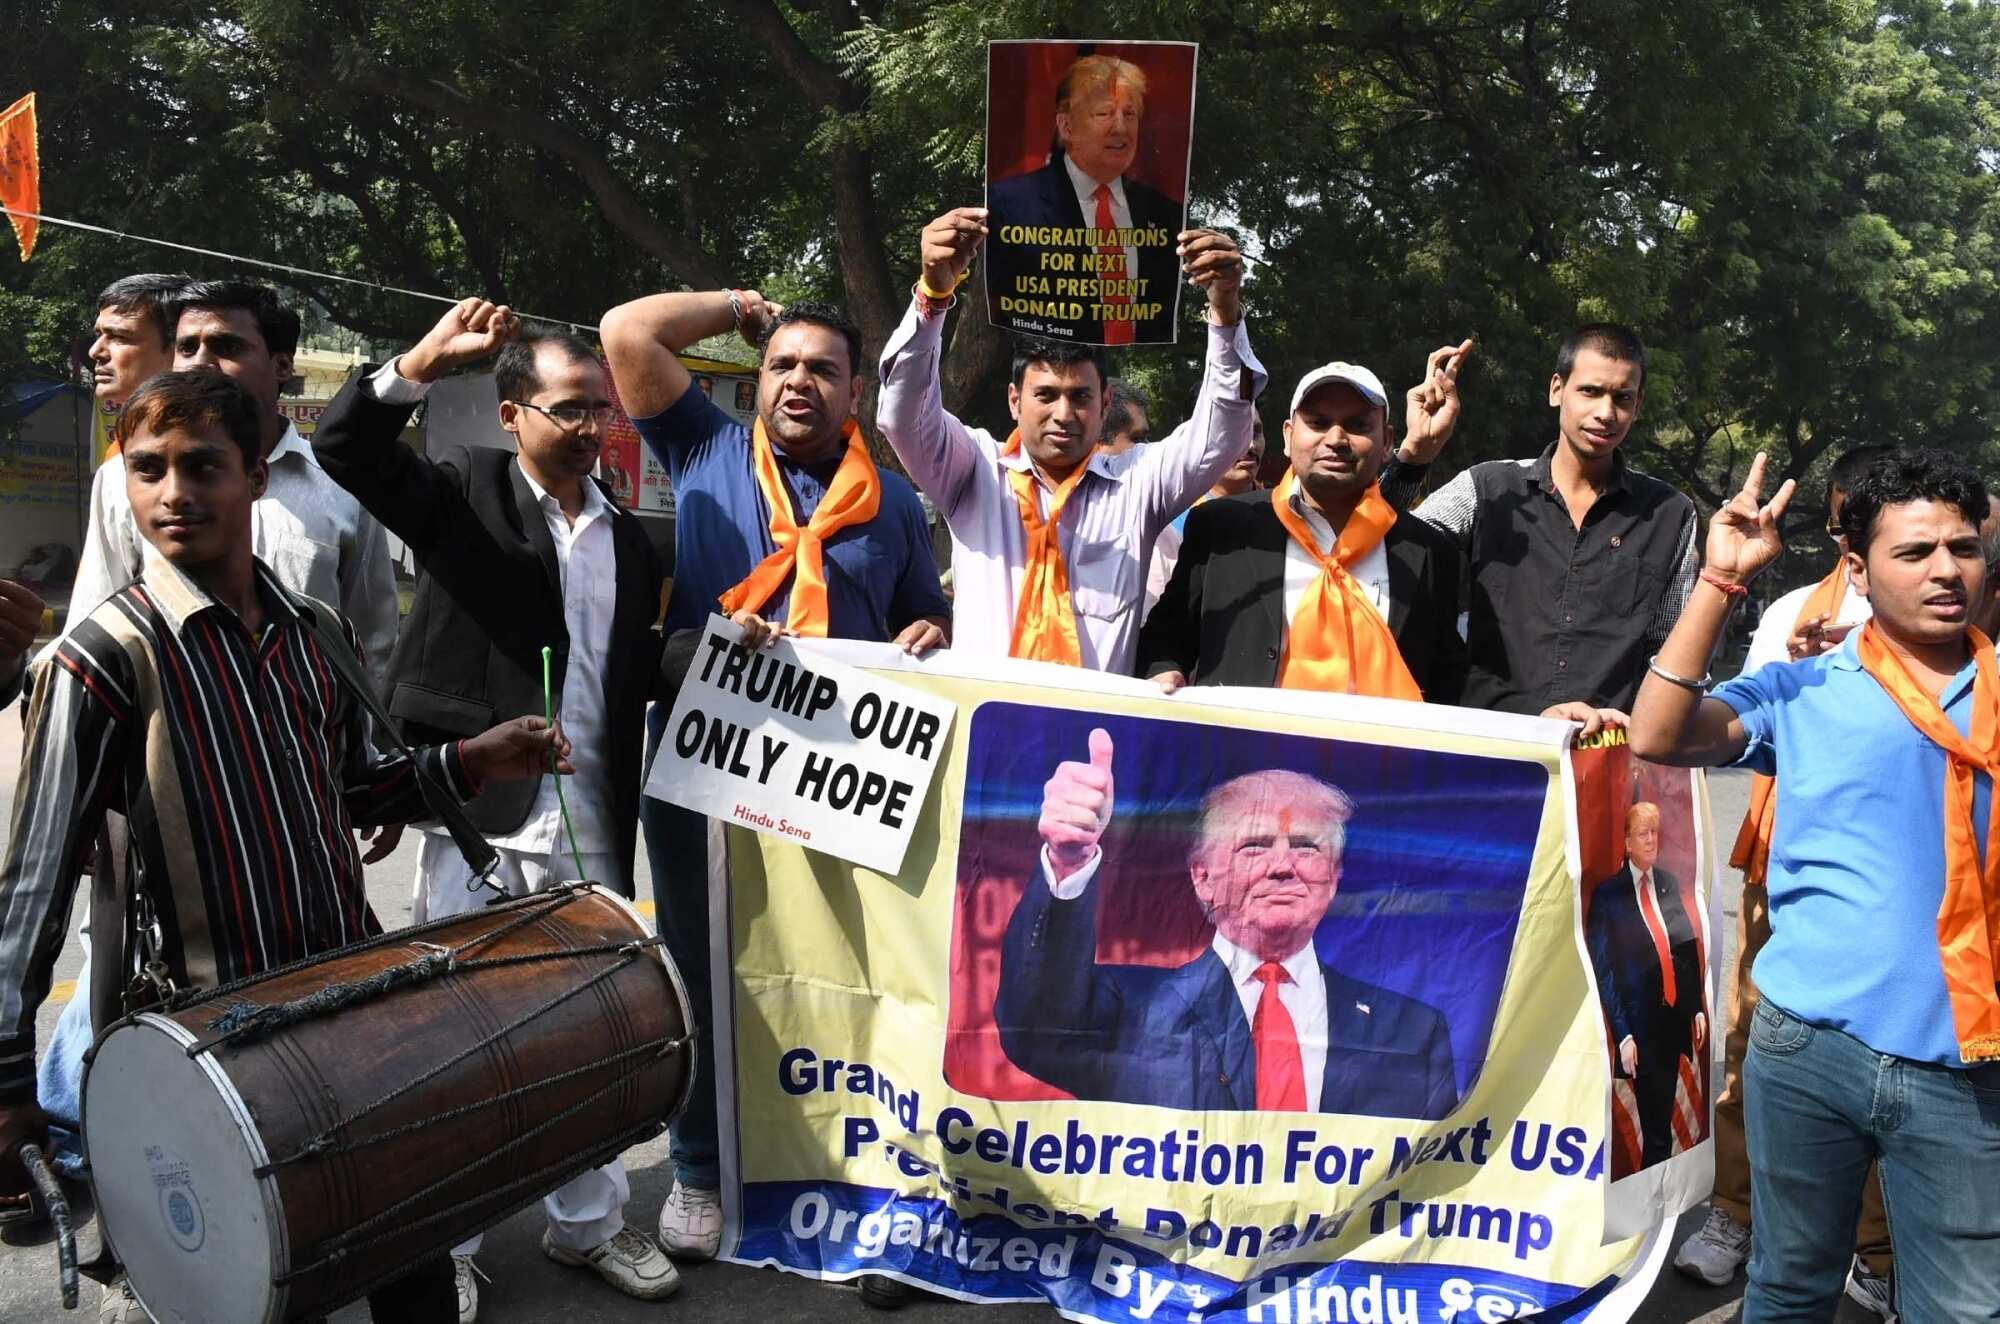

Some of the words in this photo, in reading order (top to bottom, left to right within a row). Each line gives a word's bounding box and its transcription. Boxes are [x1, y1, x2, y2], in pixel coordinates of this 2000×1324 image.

[1000, 224, 1168, 247] CONGRATULATIONS
[1041, 252, 1075, 271] FOR
[1082, 253, 1127, 272] NEXT
[1015, 275, 1050, 295] USA
[1056, 277, 1149, 297] PRESIDENT
[1000, 296, 1083, 320] DONALD
[1090, 302, 1162, 321] TRUMP
[1012, 317, 1044, 332] Hindu
[1047, 323, 1074, 337] Sena
[700, 633, 839, 721] TRUMP
[850, 692, 940, 761] OUR
[675, 708, 789, 785] ONLY
[795, 751, 914, 829] HOPE
[733, 803, 774, 829] Hindu
[777, 818, 812, 841] Sena
[778, 1047, 919, 1134] Grand
[935, 1107, 1265, 1186] Celebration
[1283, 1129, 1373, 1185] For
[1384, 1116, 1492, 1181] Next
[1143, 1207, 1353, 1258] Donald
[1368, 1188, 1554, 1260] Trump
[789, 1192, 1077, 1278] Organized
[1246, 1273, 1420, 1324] Hindu
